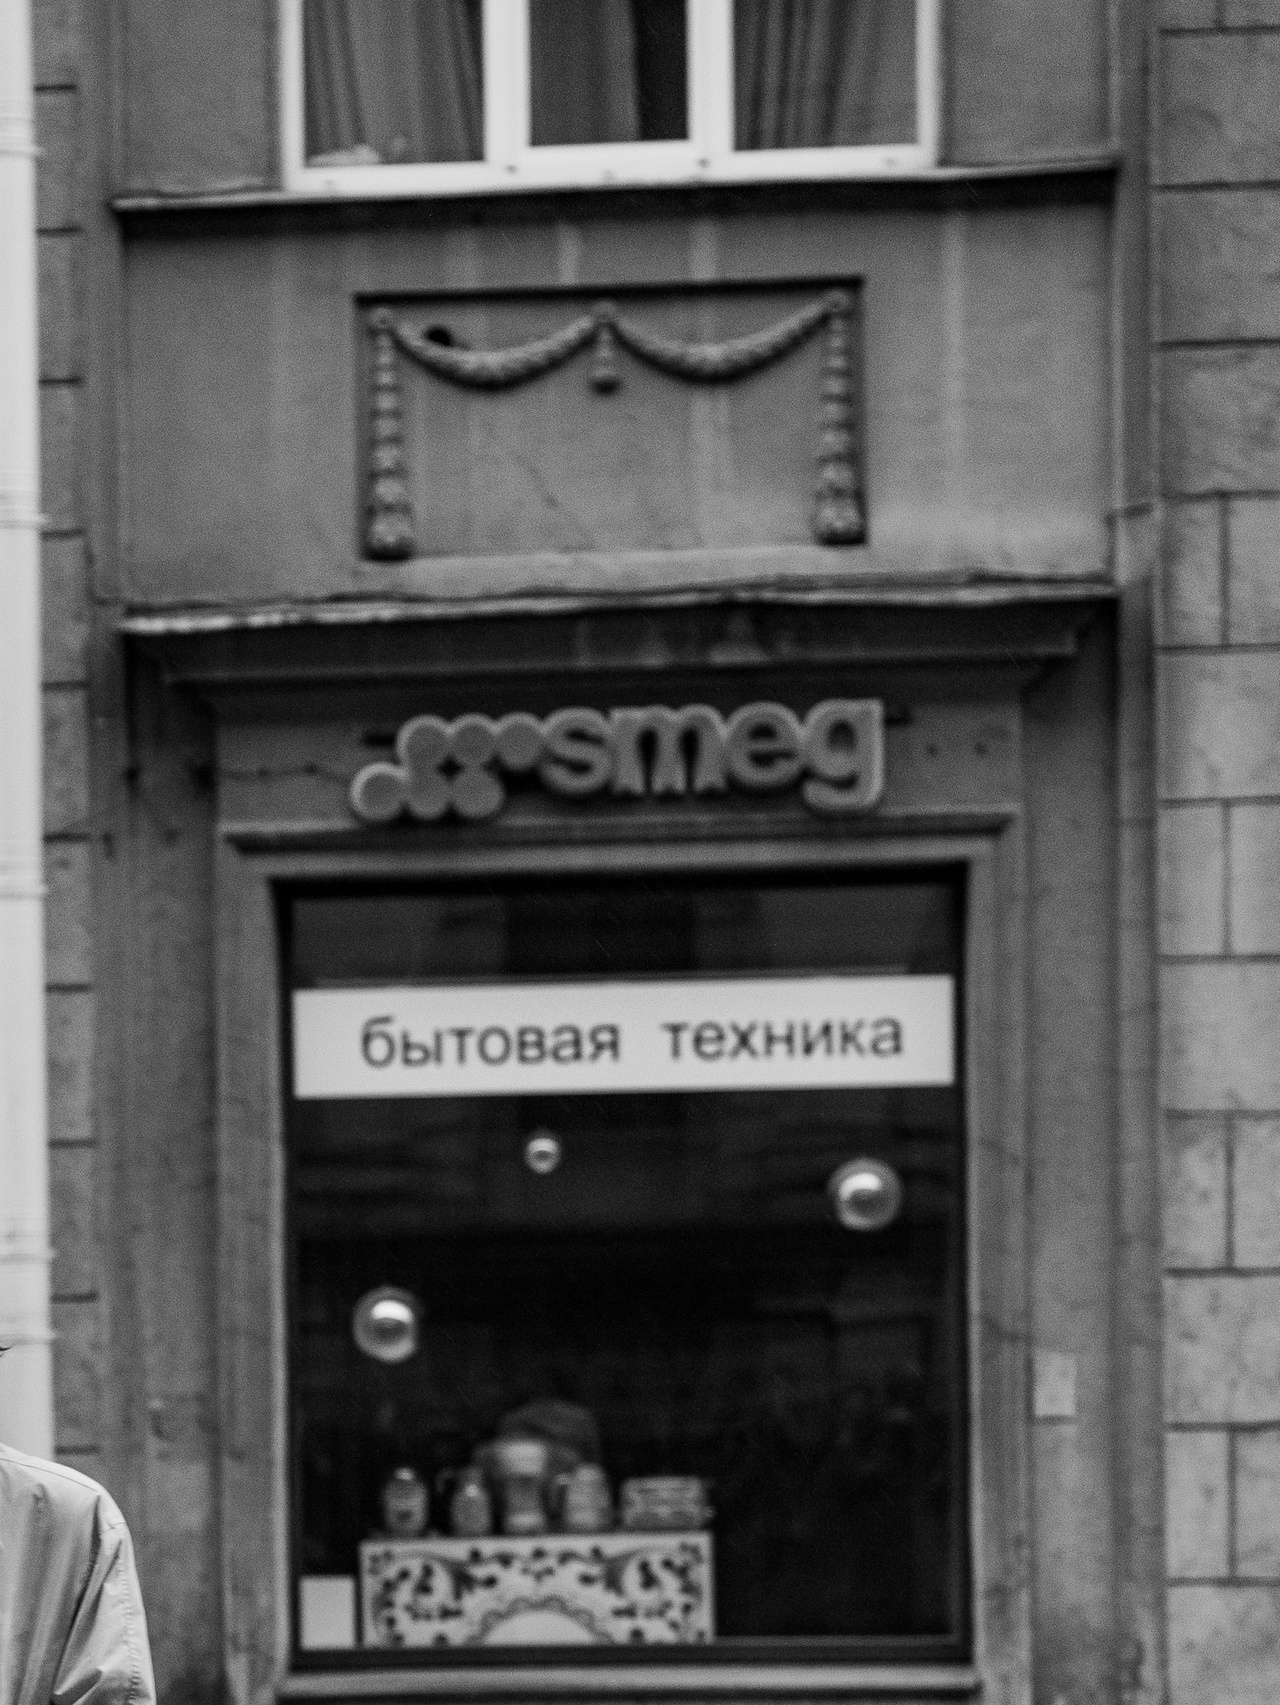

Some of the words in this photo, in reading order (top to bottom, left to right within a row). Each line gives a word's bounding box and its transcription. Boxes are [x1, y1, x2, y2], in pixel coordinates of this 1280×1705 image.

[541, 698, 886, 808] smeg
[360, 1015, 620, 1068] бытовая
[660, 1016, 904, 1061] техника
